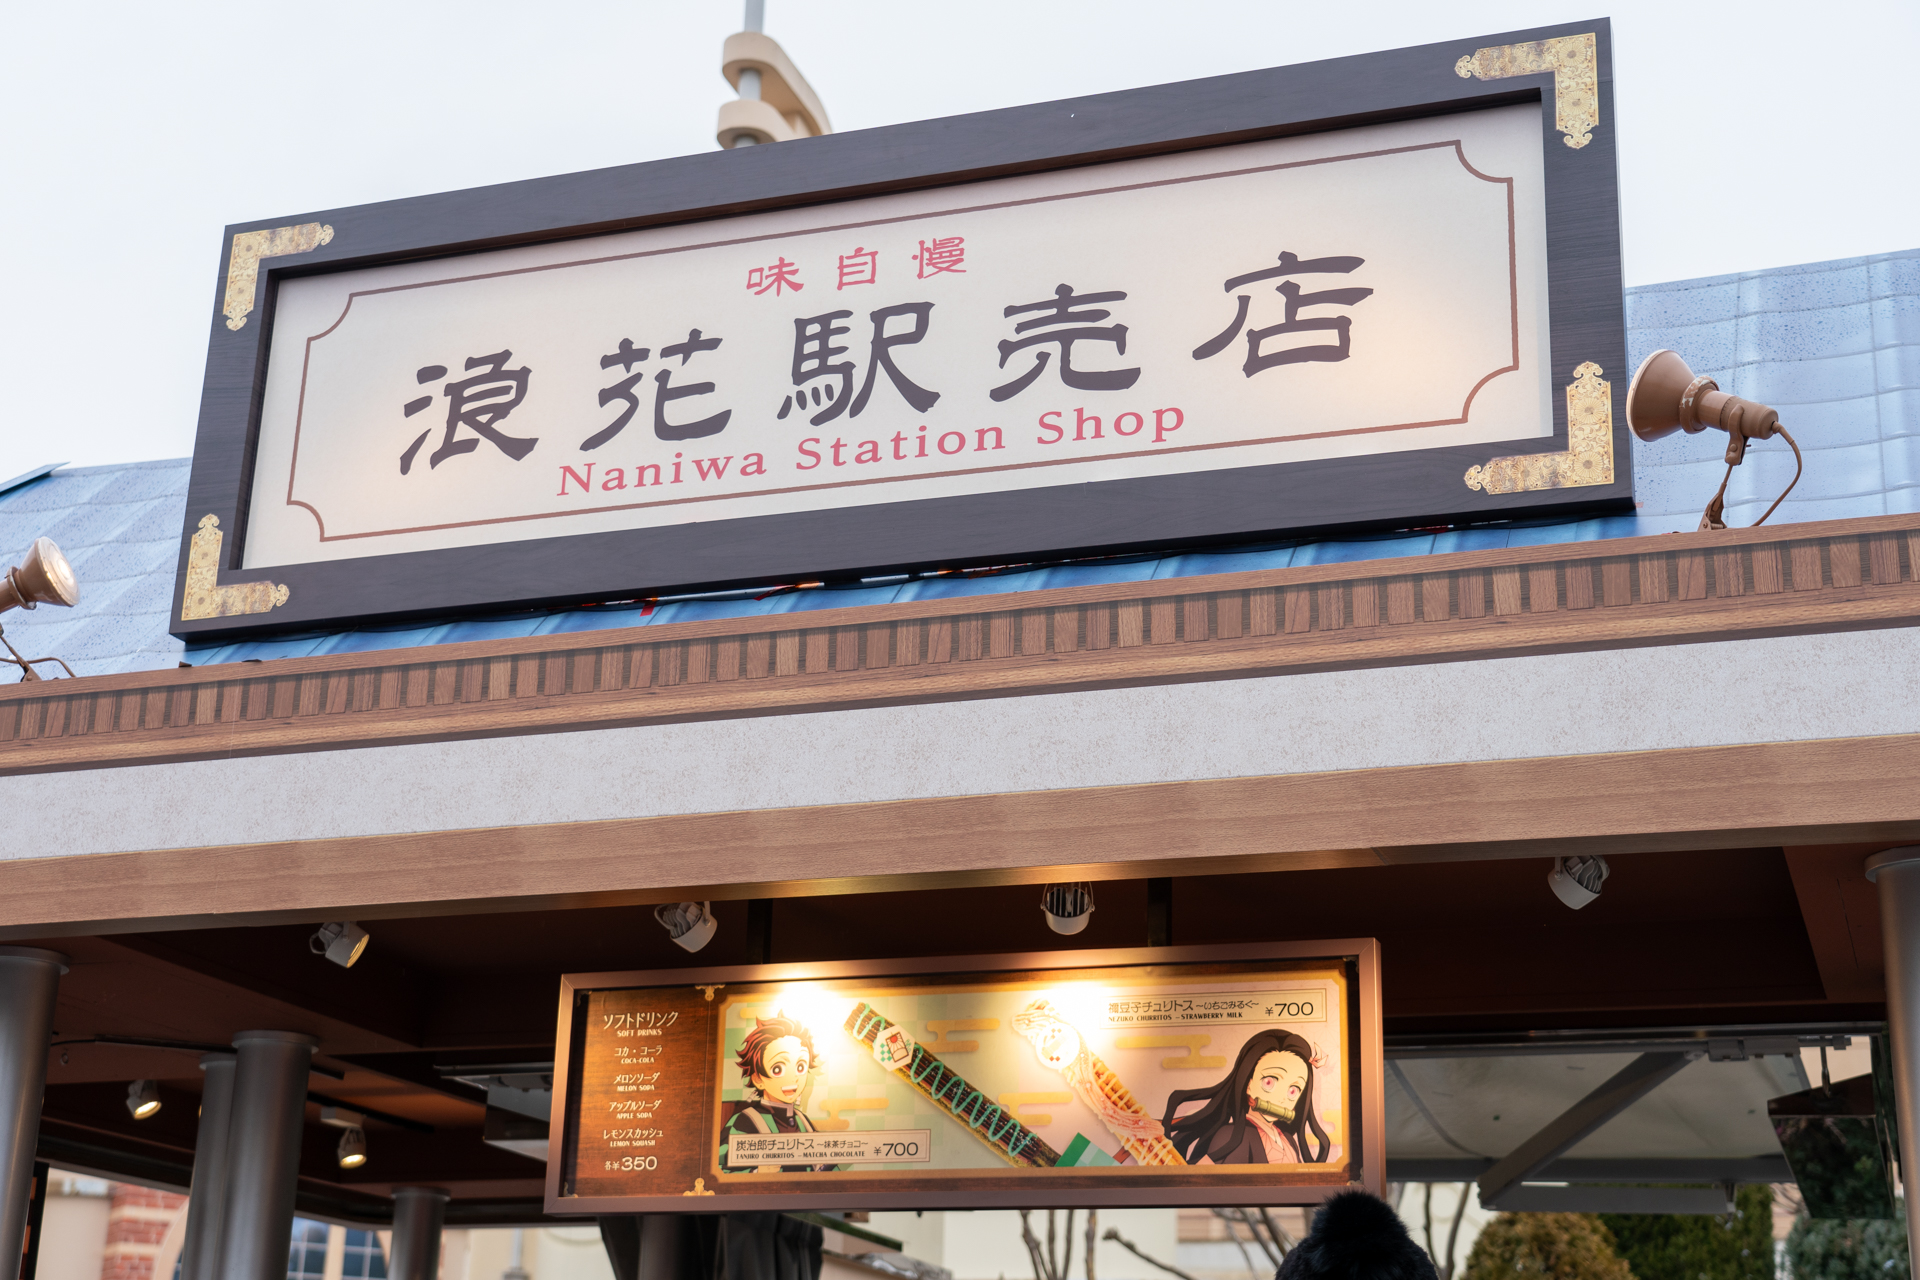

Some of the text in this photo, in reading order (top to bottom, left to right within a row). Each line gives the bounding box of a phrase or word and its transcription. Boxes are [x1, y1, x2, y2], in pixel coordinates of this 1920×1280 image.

[746, 236, 967, 297] 味自慢
[401, 251, 1374, 475] 浪花駅売店
[557, 405, 1184, 496] Naniwa Station Shop
[1264, 1002, 1314, 1017] ¥700
[603, 1011, 679, 1030] ソフトドリンク
[617, 1028, 663, 1037] SOFT DRINKS
[614, 1045, 663, 1057] コカ・コーラ
[613, 1071, 661, 1084] メロンソーダ
[609, 1099, 662, 1112] アップルソーダ
[603, 1127, 664, 1140] レモンスカッシュ
[829, 1150, 866, 1158] CHOCOLATE
[873, 1142, 919, 1156] ¥700
